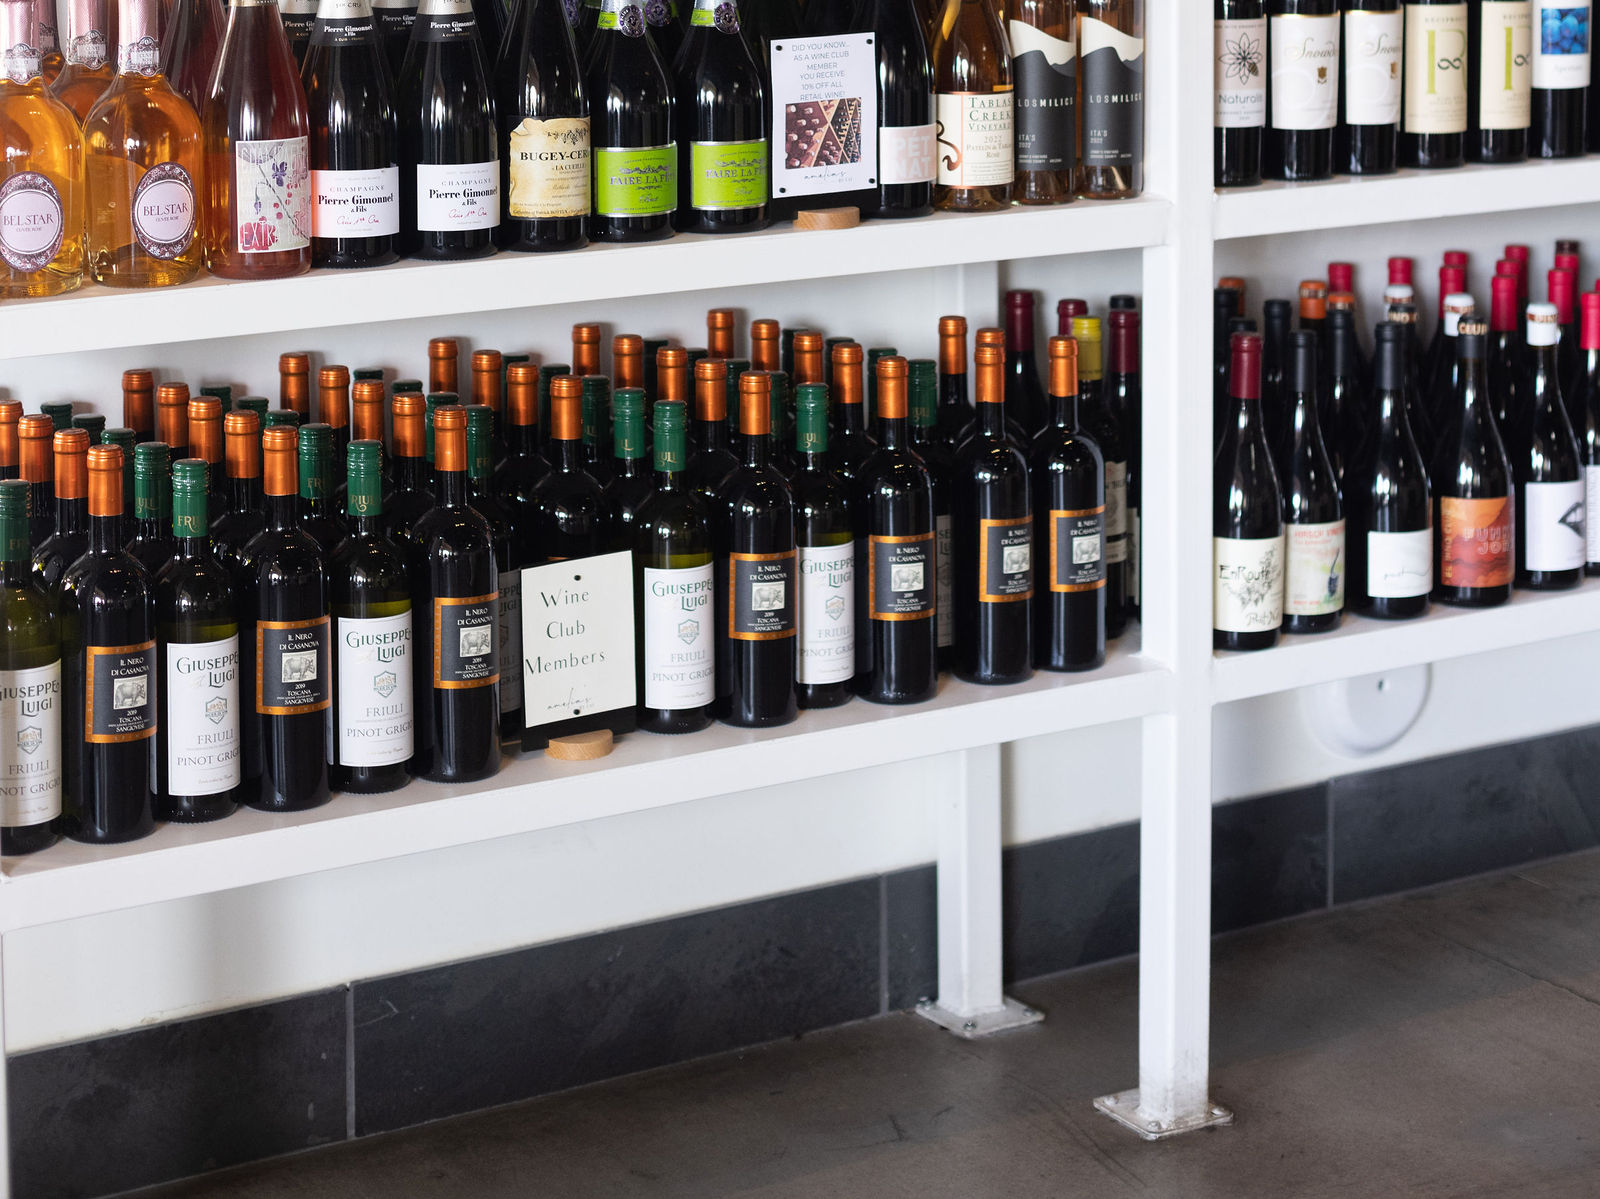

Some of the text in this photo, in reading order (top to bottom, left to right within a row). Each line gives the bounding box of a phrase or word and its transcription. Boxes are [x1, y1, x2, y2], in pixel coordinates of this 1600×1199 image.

[324, 25, 344, 33] Pierre
[430, 21, 451, 29] Pierre
[792, 44, 806, 52] DID
[806, 43, 823, 51] YOU
[793, 54, 803, 62] AS
[811, 52, 830, 60] WINE
[831, 50, 850, 59] CLUB
[806, 62, 838, 71] MEMBER
[799, 70, 845, 81] YOU RECEIVE
[802, 81, 843, 91] 10% OFF ALL
[800, 92, 823, 101] RETAIL
[968, 97, 1011, 109] TABLAS
[894, 130, 931, 157] PÉT
[705, 168, 738, 178] FAIRE
[894, 157, 931, 179] NAT
[441, 178, 491, 187] CHAMPAGNE
[609, 175, 643, 186] FAIRE
[329, 184, 385, 193] CHAMPAGNE
[429, 186, 498, 200] Pierre Gimonnet
[318, 192, 394, 205] Pierre Gimonnet
[143, 202, 189, 217] BELSTAR
[355, 205, 368, 213] Fils
[3, 213, 55, 227] BELSTAR
[652, 578, 713, 597] GIUSEPPE
[540, 587, 590, 608] Wine
[681, 594, 708, 612] LUIGI
[472, 607, 488, 615] NERO
[295, 632, 313, 640] NERO
[546, 619, 586, 640] Club
[346, 627, 411, 649] GIUSEPPE
[279, 640, 320, 651] DI CASANOVA
[377, 644, 406, 663] LUIGI
[671, 649, 706, 663] FRIULI
[127, 656, 145, 665] NERO
[176, 651, 239, 675] GIUSEPPE
[524, 650, 606, 676] Members
[208, 668, 235, 689] LUIGI
[652, 671, 687, 682] PINOT
[21, 697, 53, 717] LUIGI
[366, 703, 404, 718] FRIULI
[197, 728, 233, 745] FRIULI
[346, 727, 383, 738] PINOT
[9, 759, 50, 775] FRIULI
[177, 754, 214, 767] PINOT
